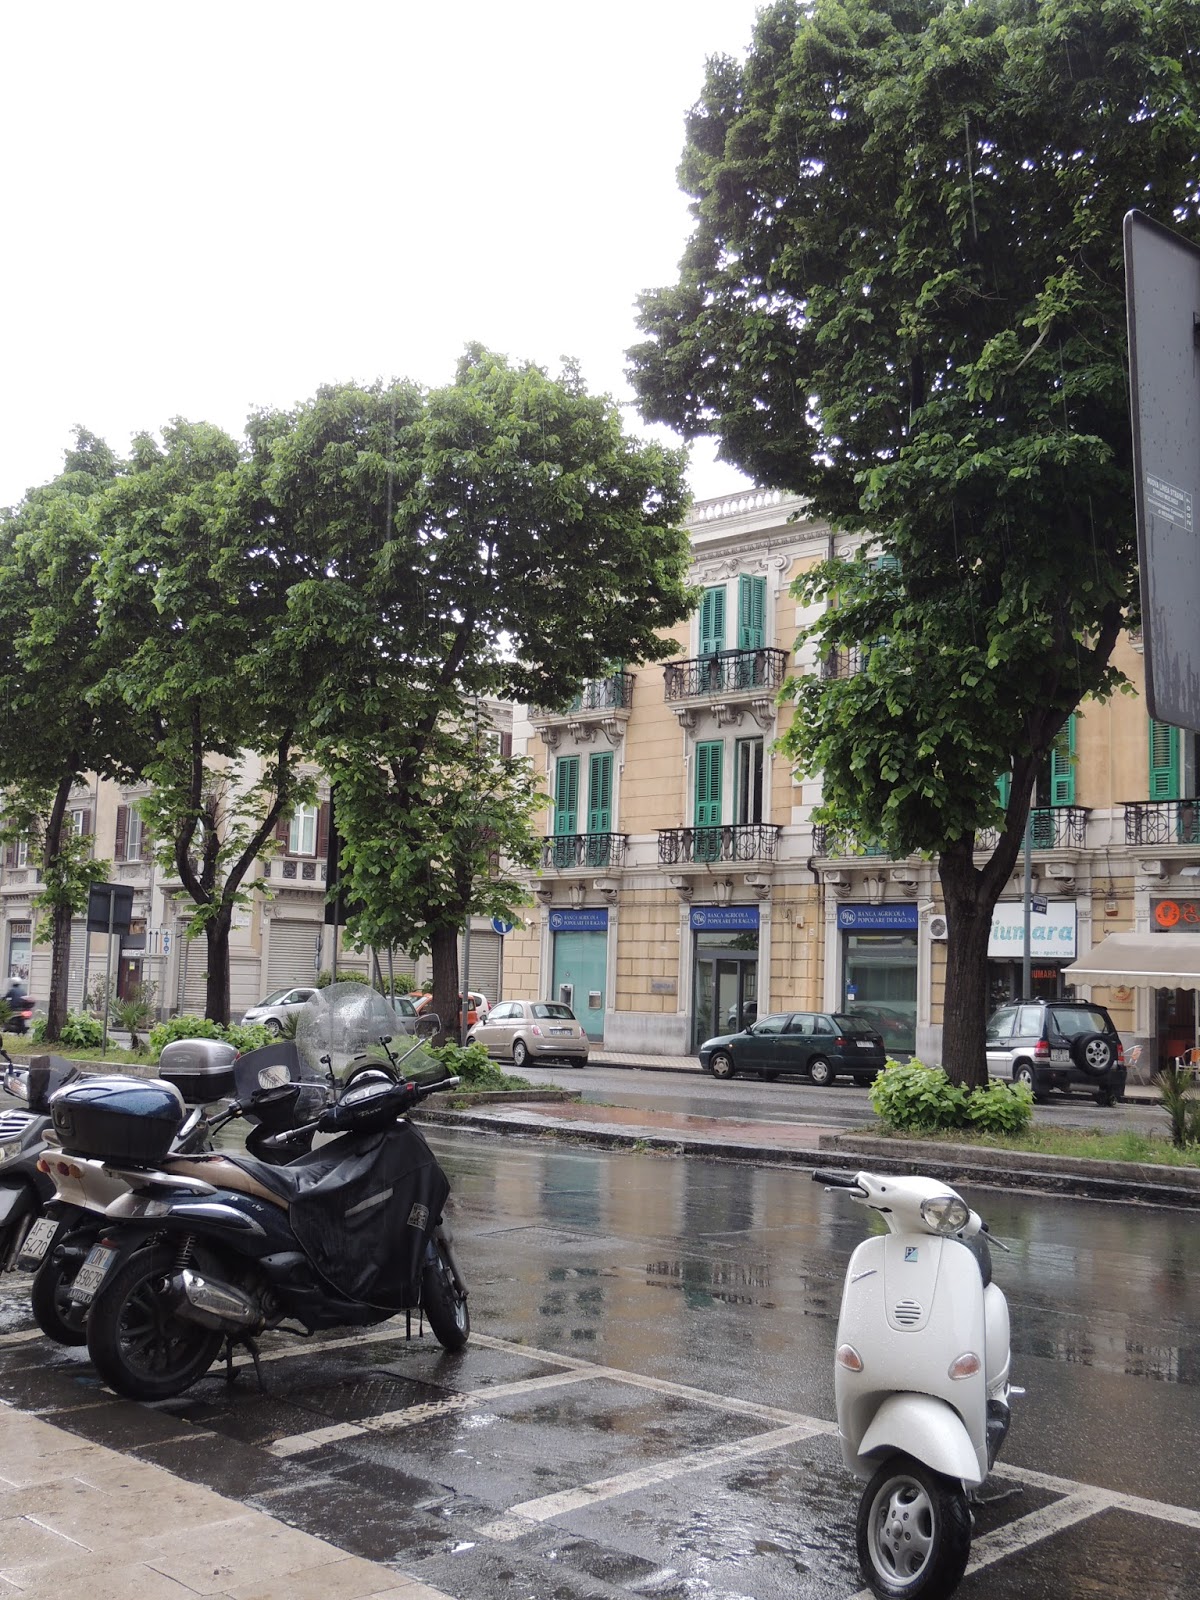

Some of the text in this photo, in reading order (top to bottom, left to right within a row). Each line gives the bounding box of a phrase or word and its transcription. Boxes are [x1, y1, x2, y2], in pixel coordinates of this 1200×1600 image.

[991, 919, 1074, 941] iumara
[1031, 969, 1057, 979] IUMARA
[75, 1267, 103, 1290] 59679
